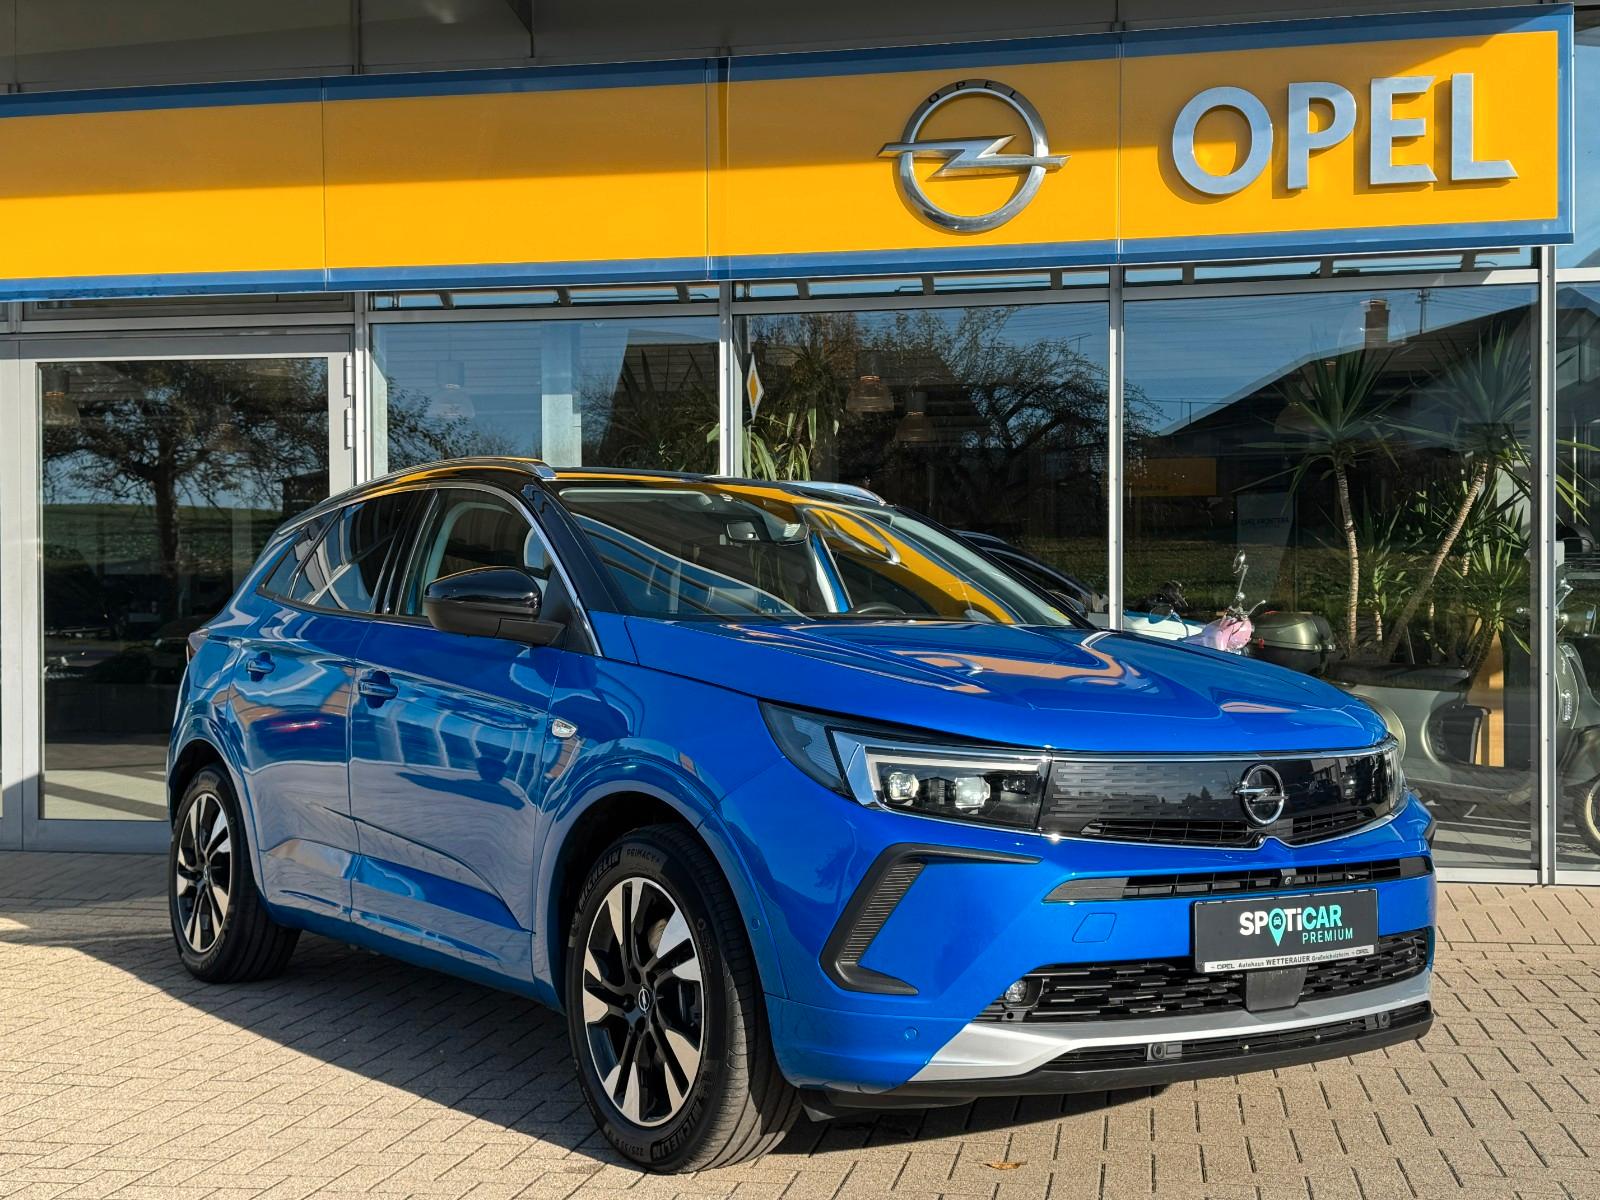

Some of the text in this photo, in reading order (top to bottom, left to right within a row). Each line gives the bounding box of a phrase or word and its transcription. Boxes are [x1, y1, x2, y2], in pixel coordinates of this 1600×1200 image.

[928, 80, 1019, 104] OPEL
[1172, 73, 1520, 195] OPEL
[1302, 927, 1353, 945] PREMIUM
[1266, 956, 1310, 966] WETTERAUER
